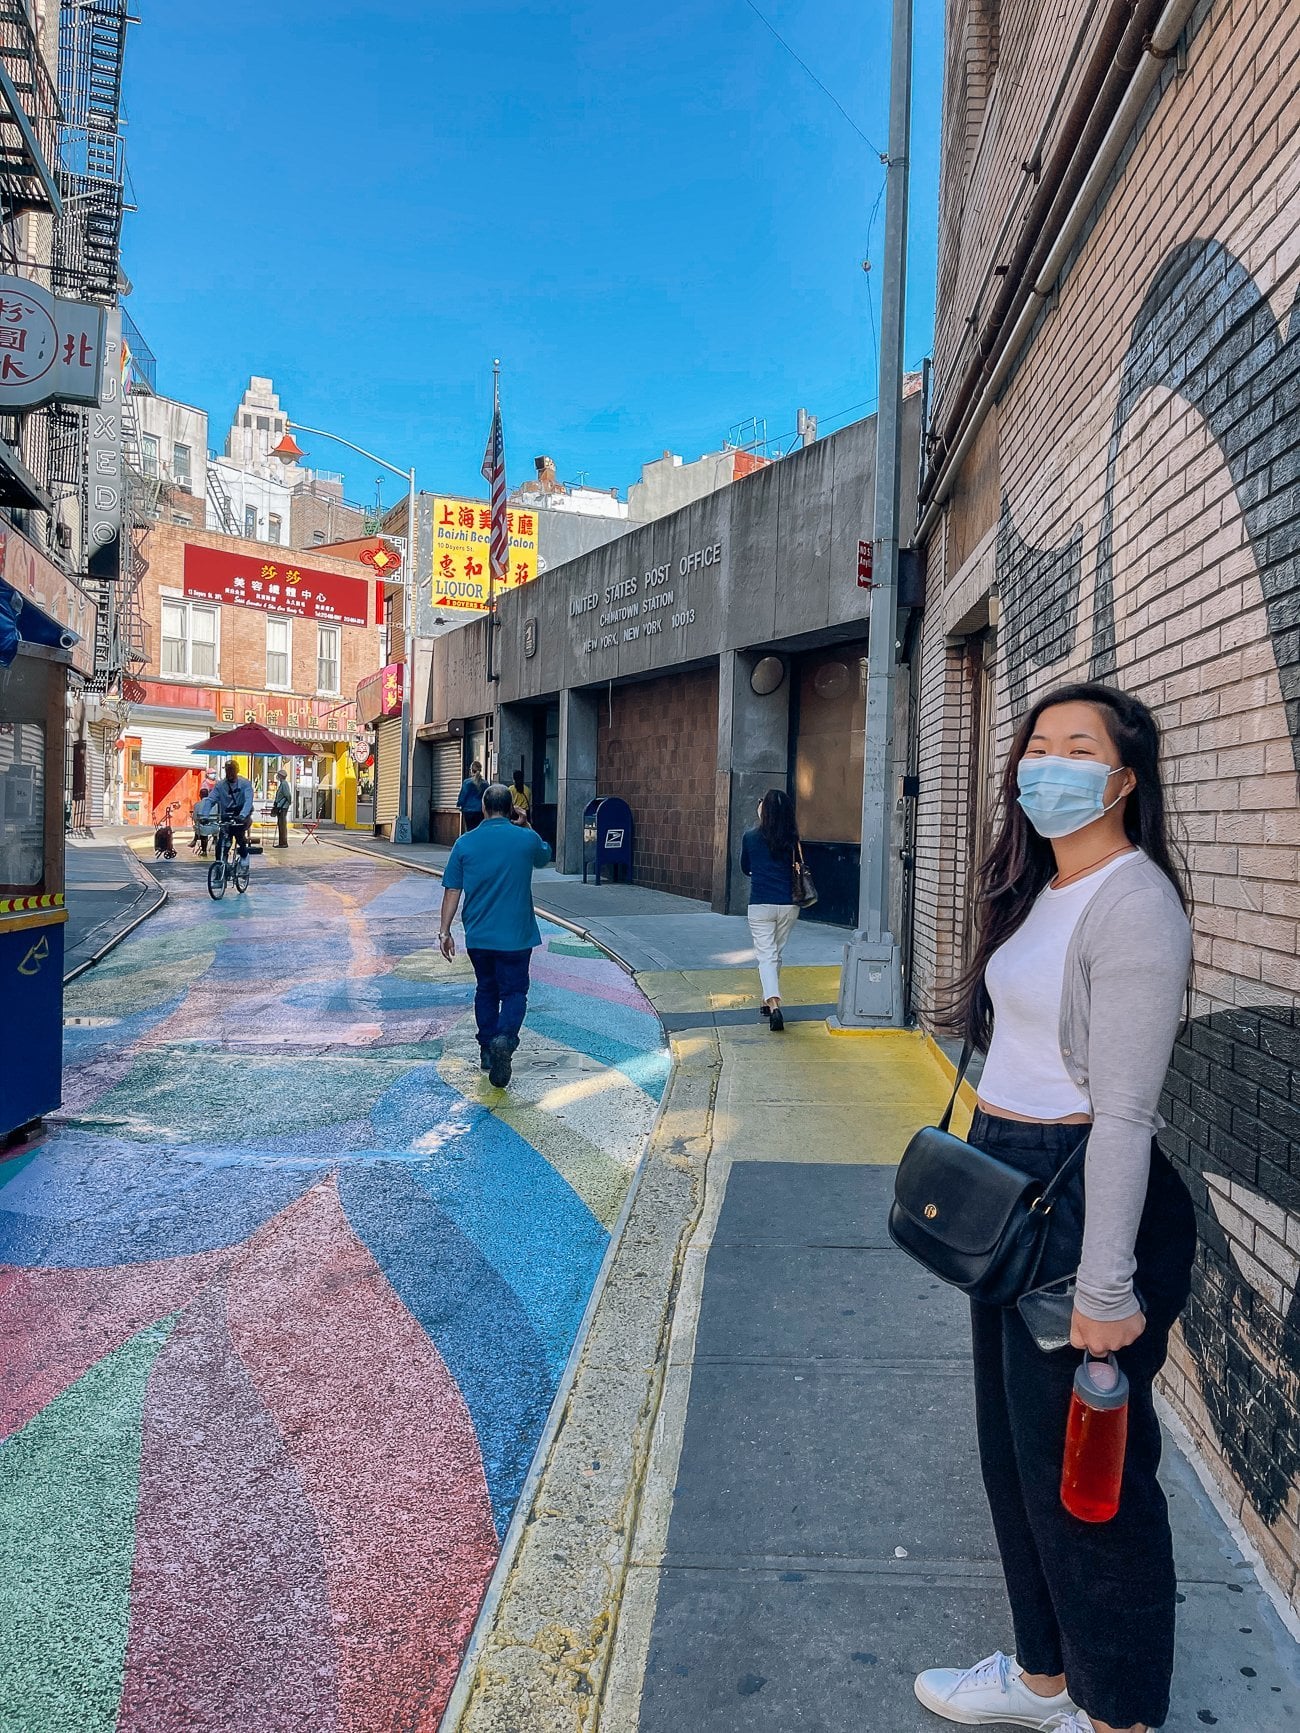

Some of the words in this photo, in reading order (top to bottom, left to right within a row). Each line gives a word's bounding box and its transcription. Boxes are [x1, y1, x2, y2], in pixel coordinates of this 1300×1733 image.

[62, 332, 93, 367] 北
[438, 527, 468, 541] Baishi
[508, 536, 534, 550] Salon
[261, 565, 302, 585] 莎莎
[439, 554, 529, 585] 惠和莊
[569, 592, 599, 618] UNITED
[604, 576, 638, 605] STATES
[644, 563, 671, 590] POST
[679, 543, 721, 576] OFFICE
[436, 580, 483, 599] LIQUOR
[600, 602, 639, 627] CHINATOWN
[642, 590, 674, 614] STATION
[583, 638, 598, 655] NEW
[600, 632, 619, 649] YORK,
[623, 625, 640, 642] NEW
[642, 618, 663, 636] YORK
[671, 608, 695, 630] 10013
